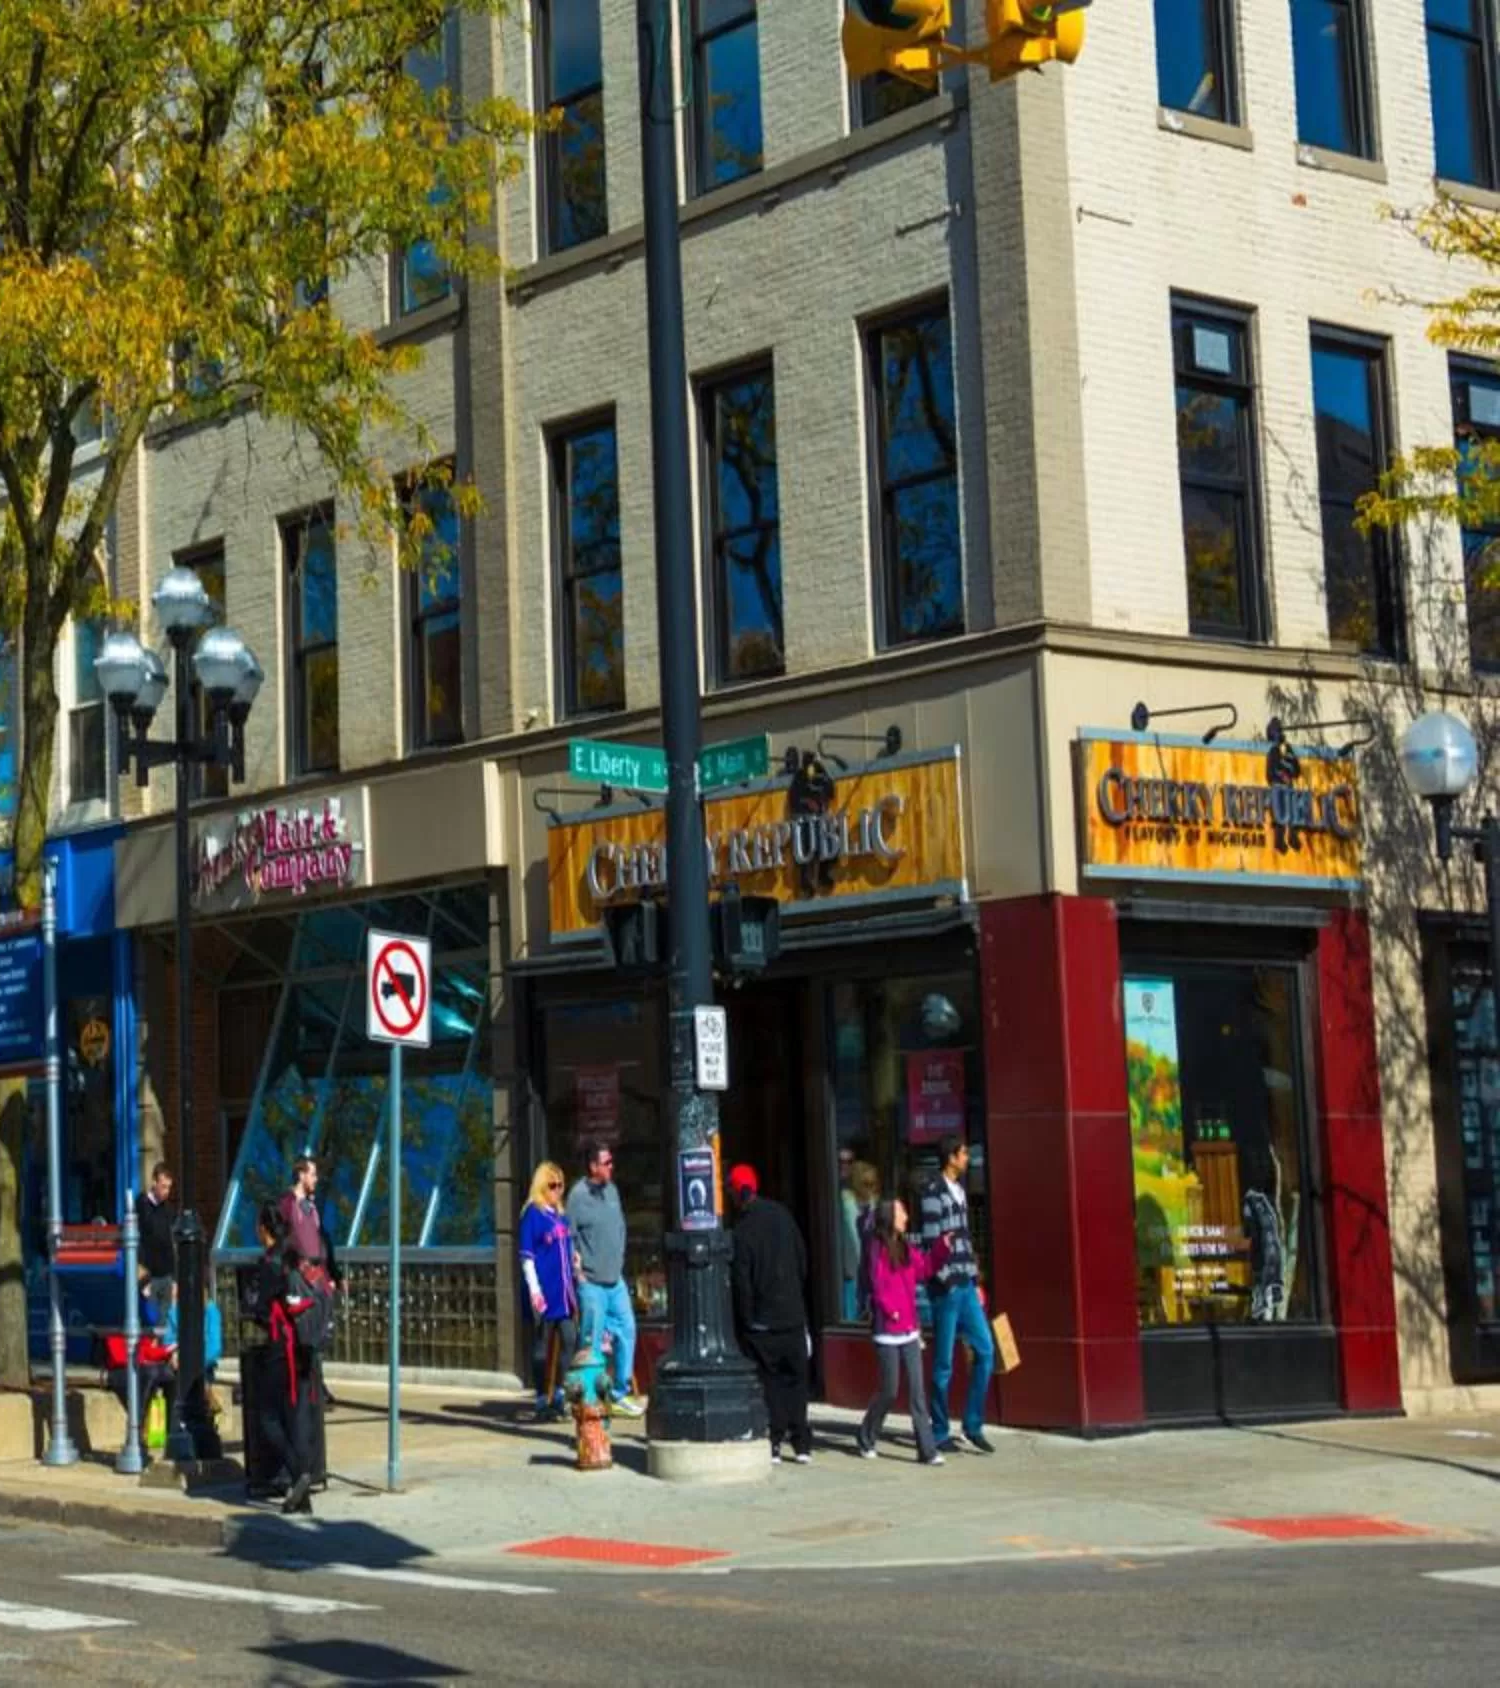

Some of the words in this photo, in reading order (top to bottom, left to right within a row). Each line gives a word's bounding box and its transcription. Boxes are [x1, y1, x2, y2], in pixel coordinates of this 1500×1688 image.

[591, 748, 640, 788] Liberty
[1097, 768, 1217, 827] CHERRY
[1221, 782, 1361, 839] REPUBLIC
[262, 806, 315, 855] Hair
[587, 833, 722, 897] CHEY
[728, 795, 905, 874] REPUBLIC
[1206, 831, 1266, 849] MICHIGAN
[244, 842, 353, 897] Company
